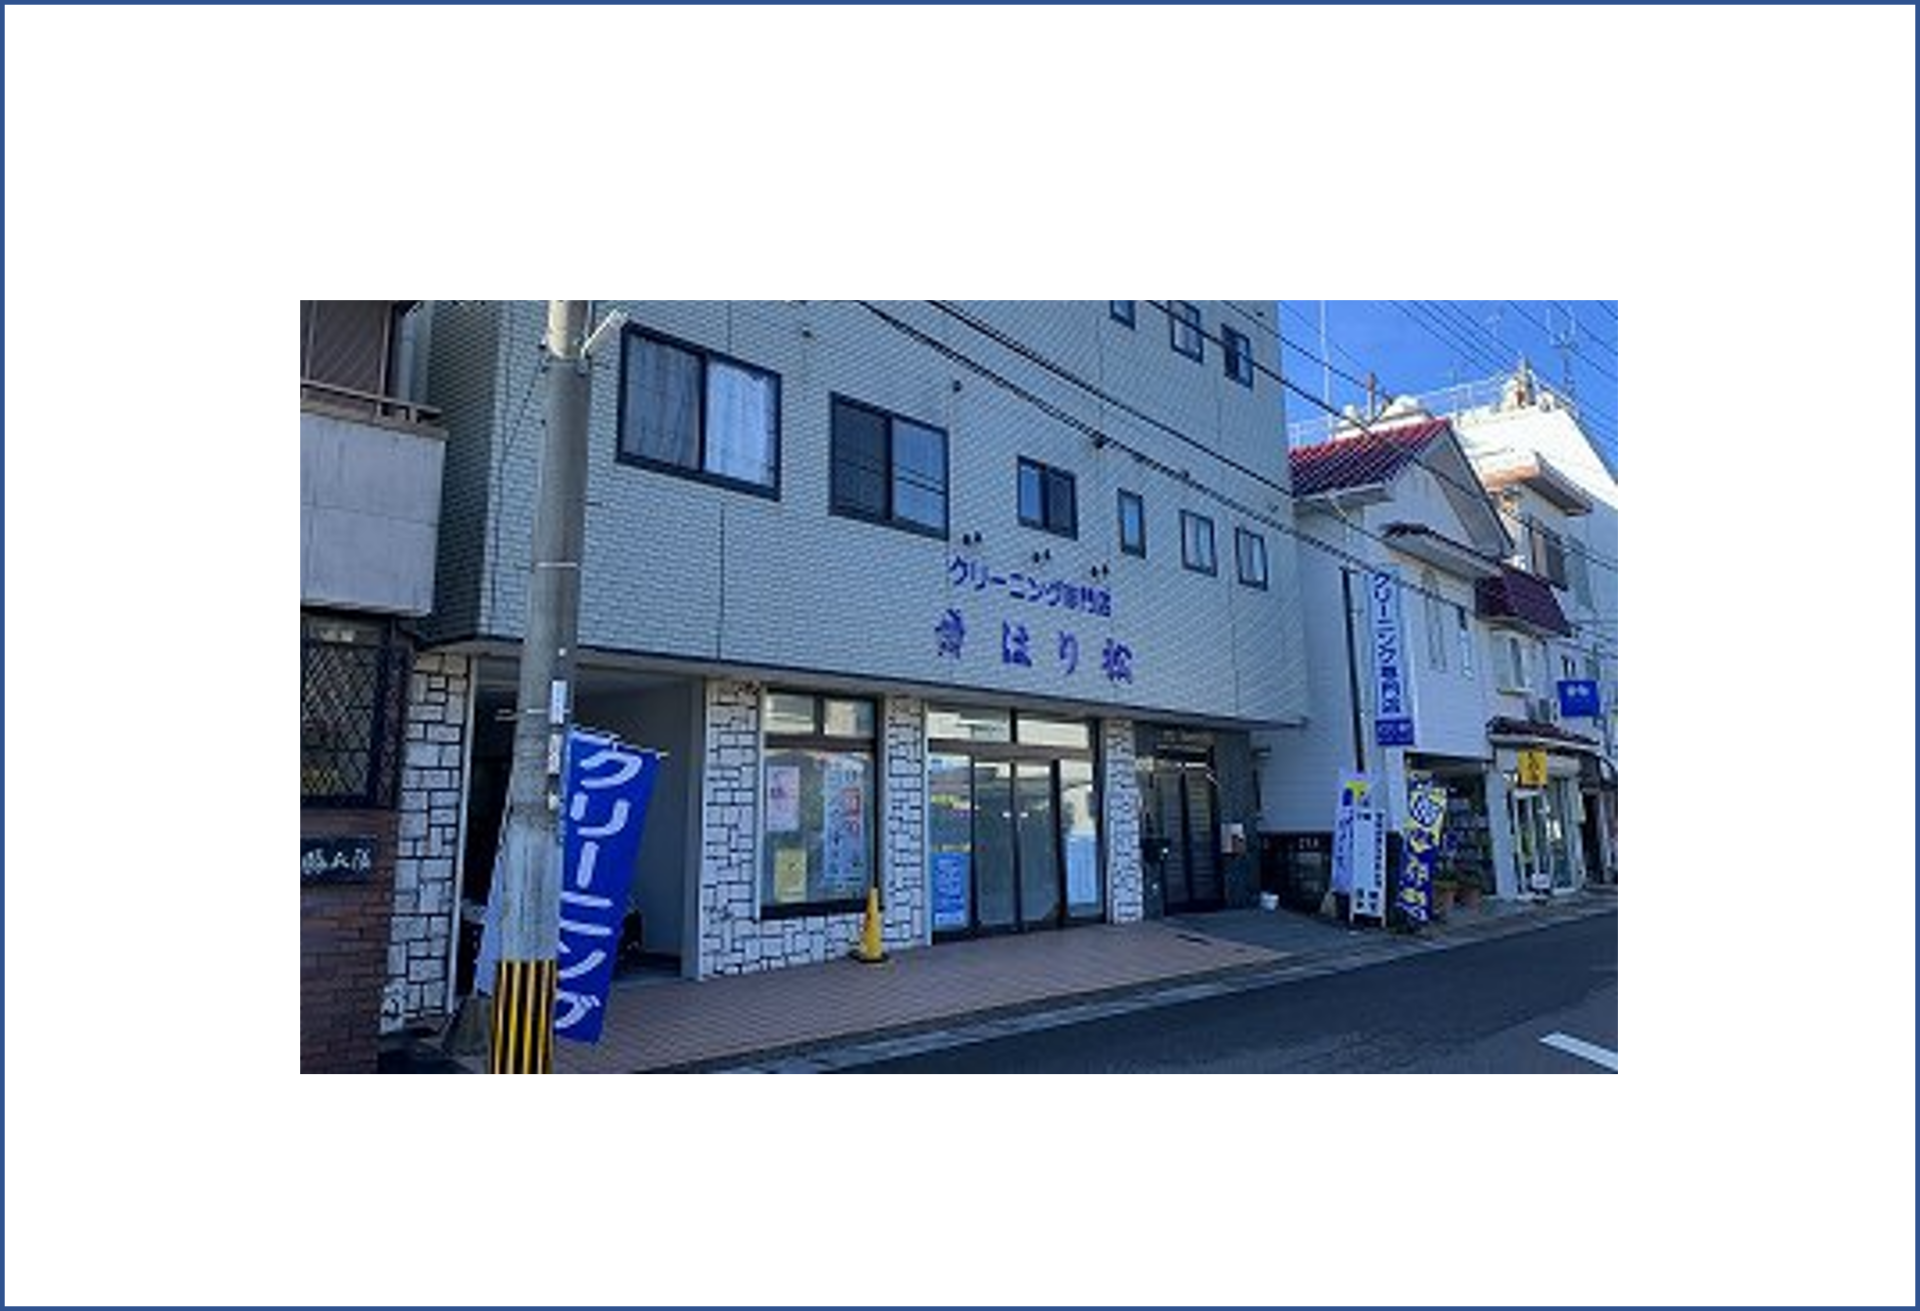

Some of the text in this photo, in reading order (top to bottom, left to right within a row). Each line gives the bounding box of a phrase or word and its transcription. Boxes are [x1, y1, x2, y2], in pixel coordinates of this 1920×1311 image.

[554, 748, 643, 1029] クリーニング
